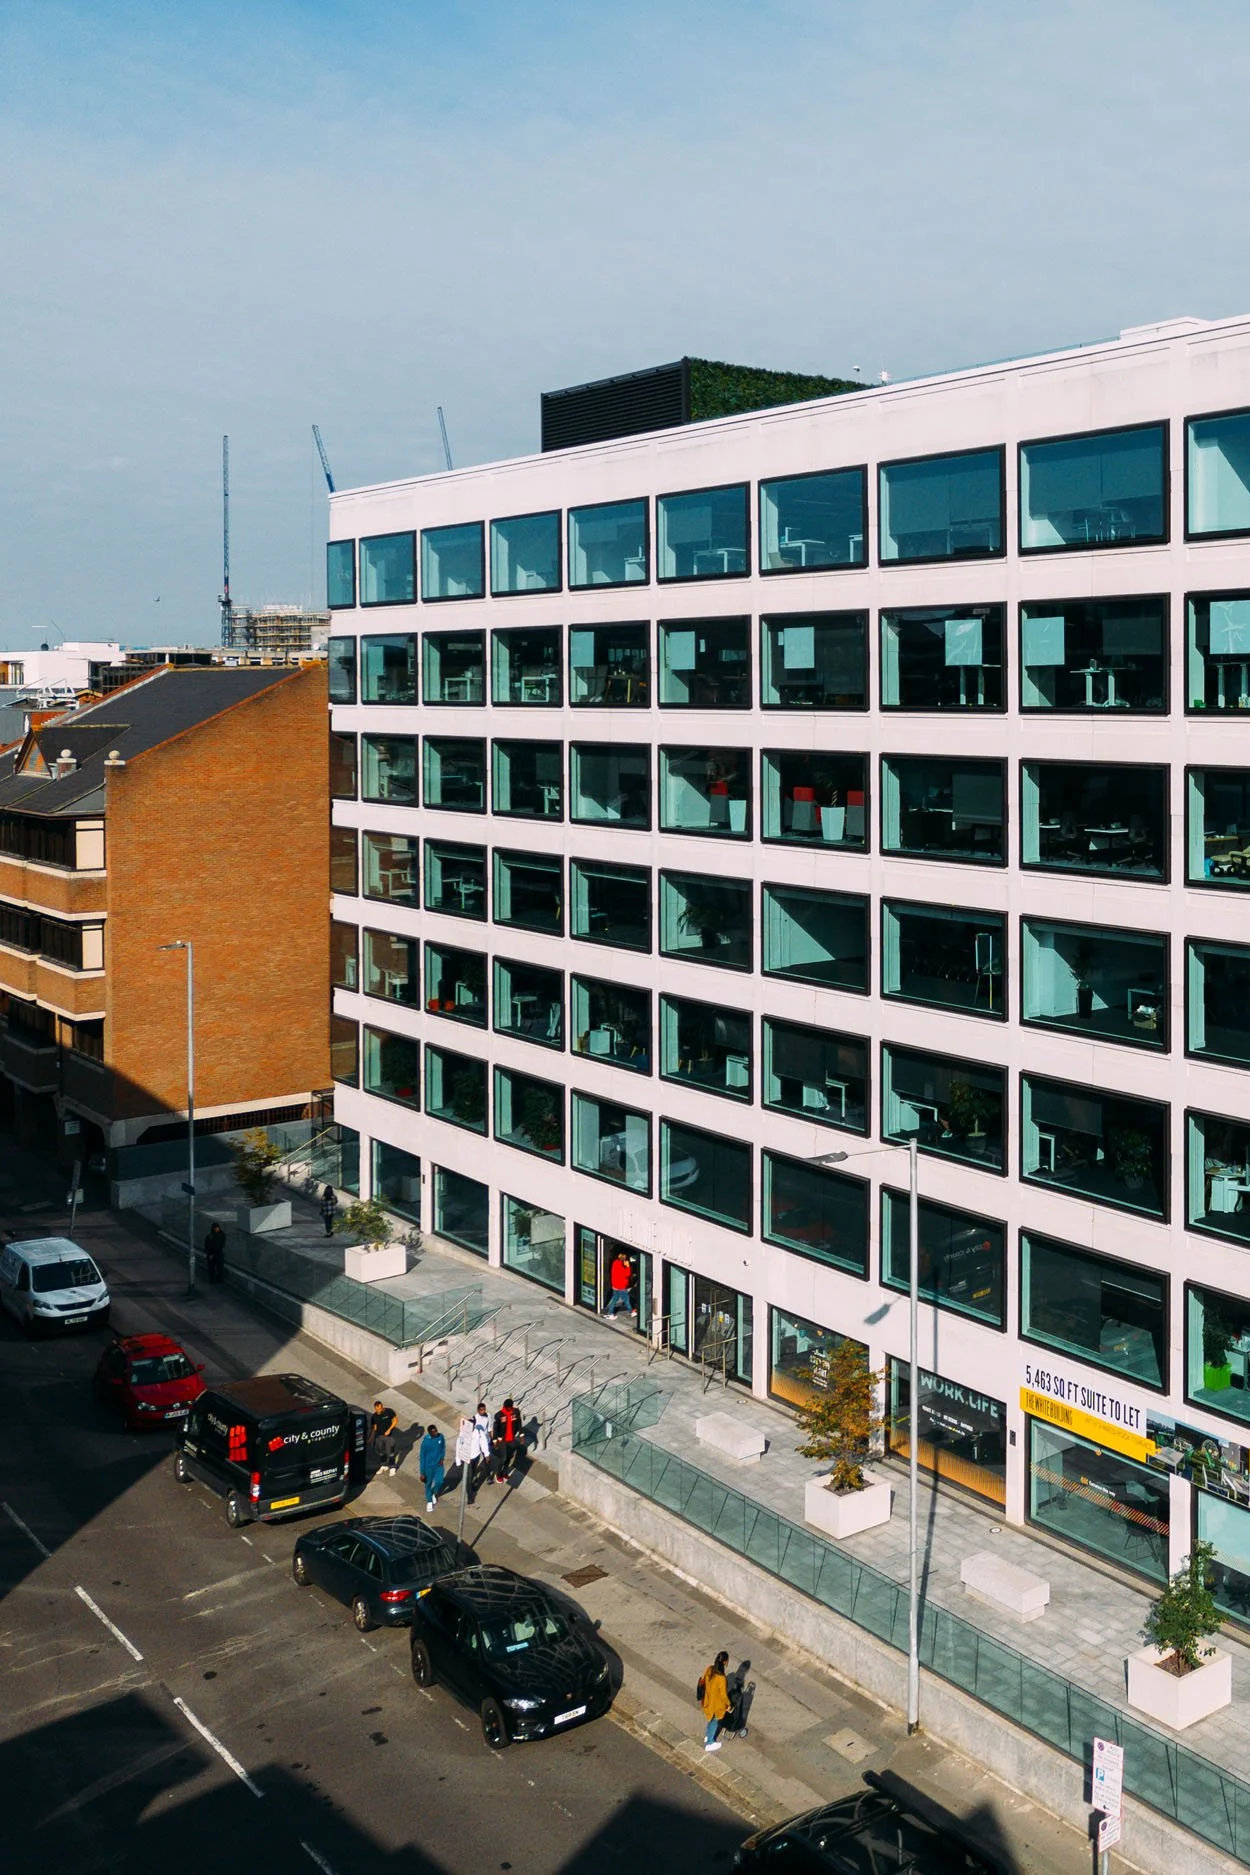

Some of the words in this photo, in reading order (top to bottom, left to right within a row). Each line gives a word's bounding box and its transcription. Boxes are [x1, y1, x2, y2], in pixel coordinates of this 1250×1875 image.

[920, 1374, 999, 1418] WORK.LIFE
[1026, 1364, 1051, 1392] 5,463
[1053, 1376, 1065, 1399] SQ
[1067, 1381, 1079, 1403] FT
[1081, 1387, 1107, 1416] SUITE
[1109, 1398, 1121, 1421] TO
[1123, 1404, 1141, 1429] LET
[283, 1433, 300, 1444] city
[301, 1431, 309, 1440] &
[310, 1424, 340, 1438] county
